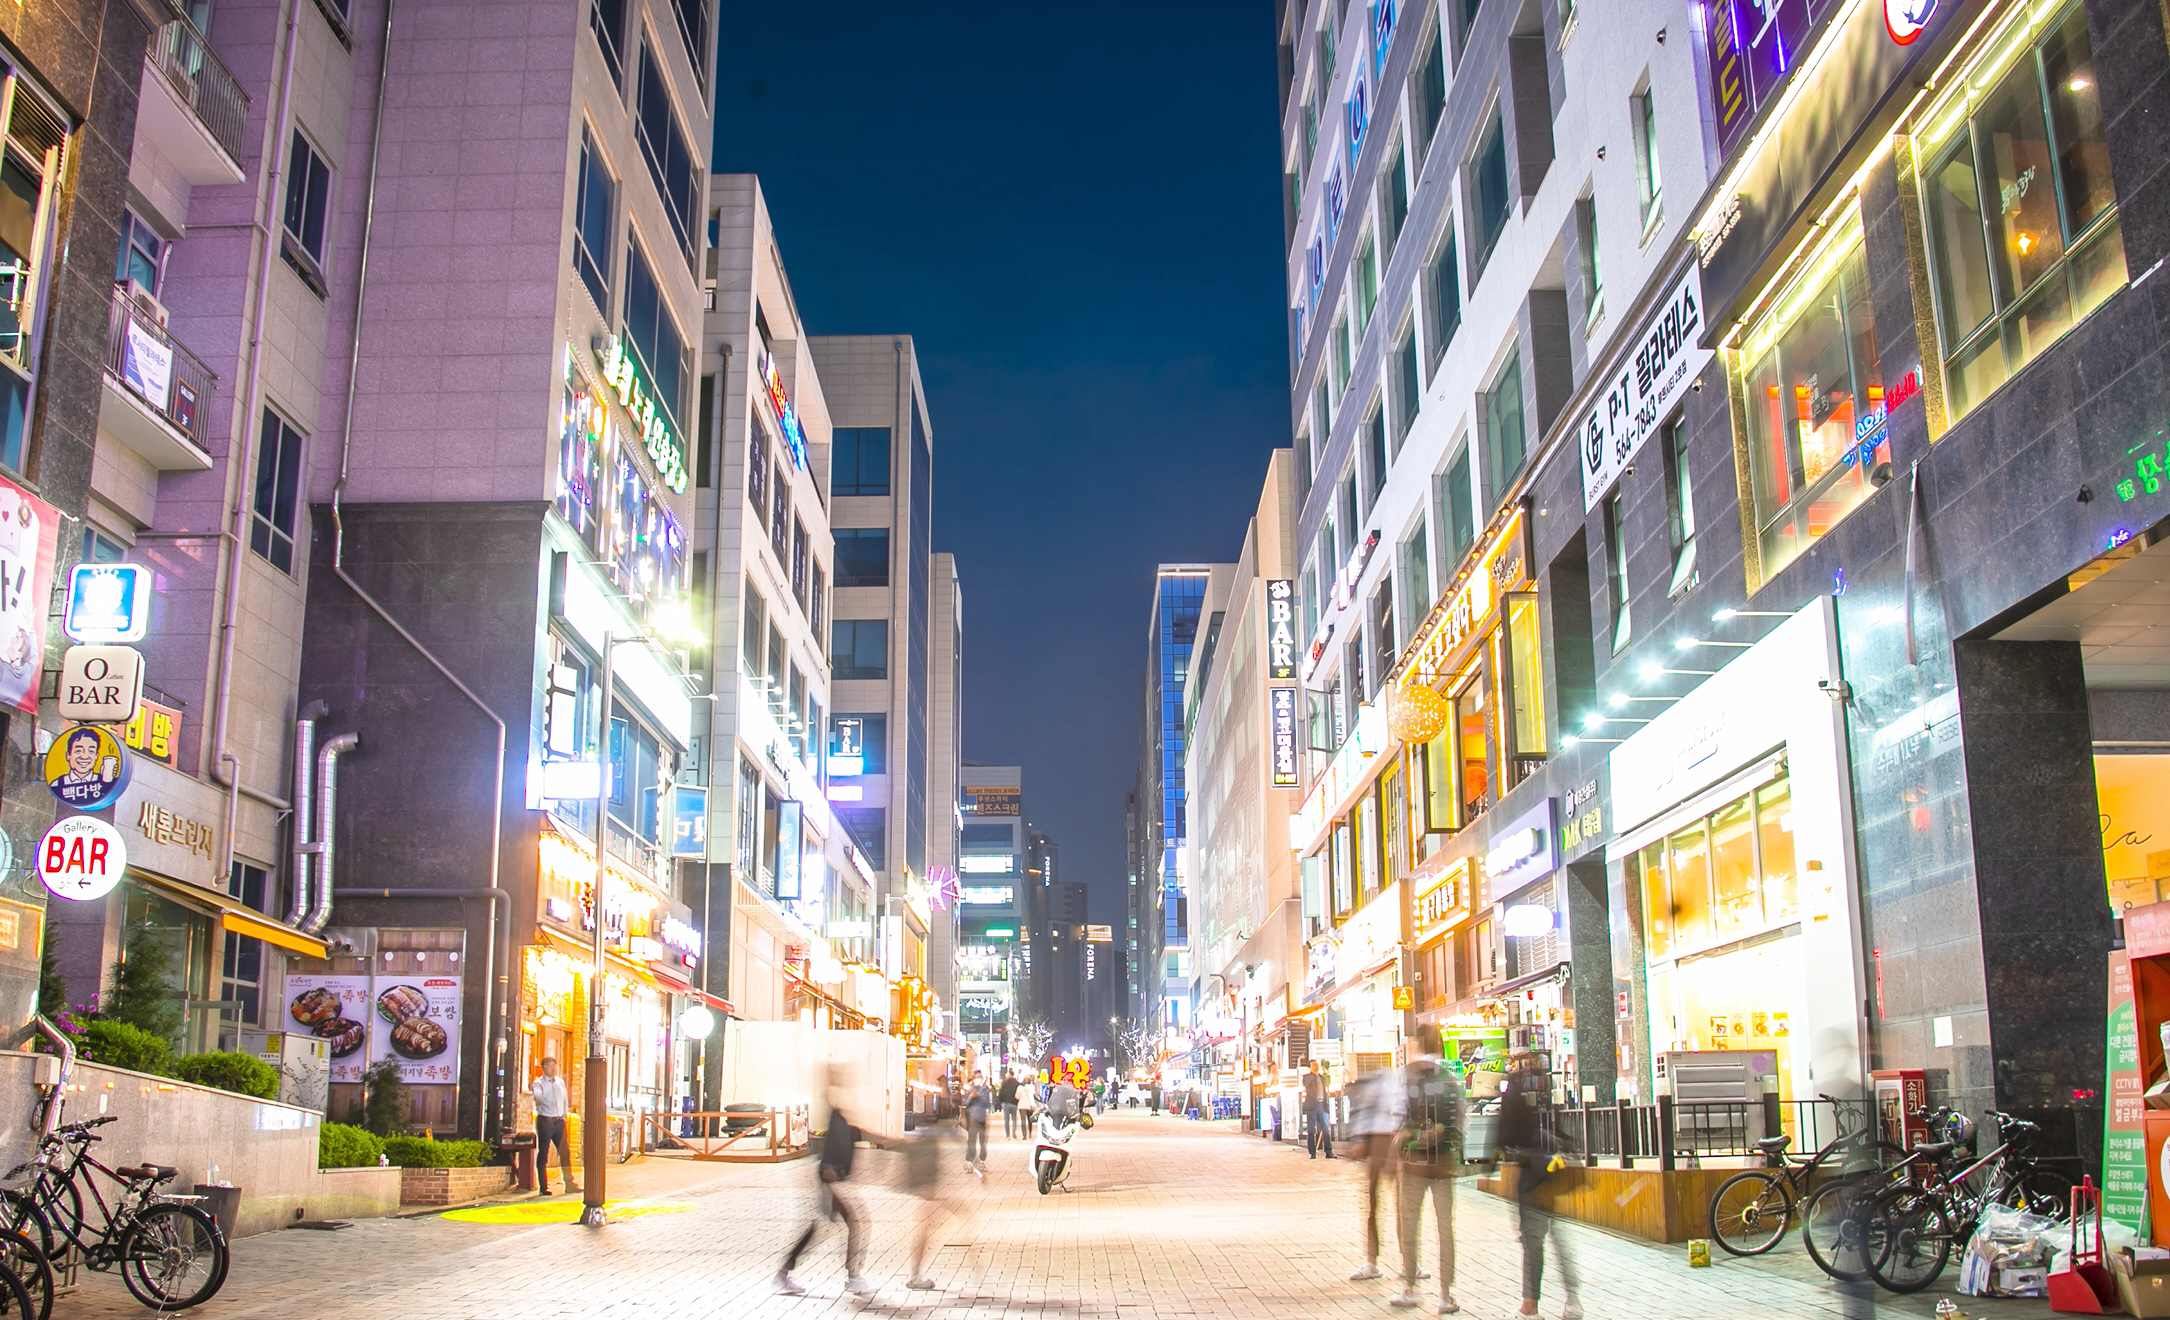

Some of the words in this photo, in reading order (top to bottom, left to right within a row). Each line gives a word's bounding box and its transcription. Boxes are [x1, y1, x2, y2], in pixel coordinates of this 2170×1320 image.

[1636, 284, 1699, 399] 필라테스
[1270, 599, 1294, 667] BAR
[84, 657, 109, 681] O
[67, 685, 122, 705] BAR
[62, 783, 103, 801] 빽다방
[63, 821, 98, 834] Gallery
[45, 835, 109, 875] BAR
[1043, 856, 1051, 887] FORENA
[1086, 943, 1095, 981] FORENA
[428, 1005, 457, 1021] 보쌈
[399, 1067, 424, 1078] 리지널
[424, 1065, 452, 1081] 족발
[2115, 1078, 2132, 1089] CCTV
[1906, 1081, 1918, 1116] 소화기
